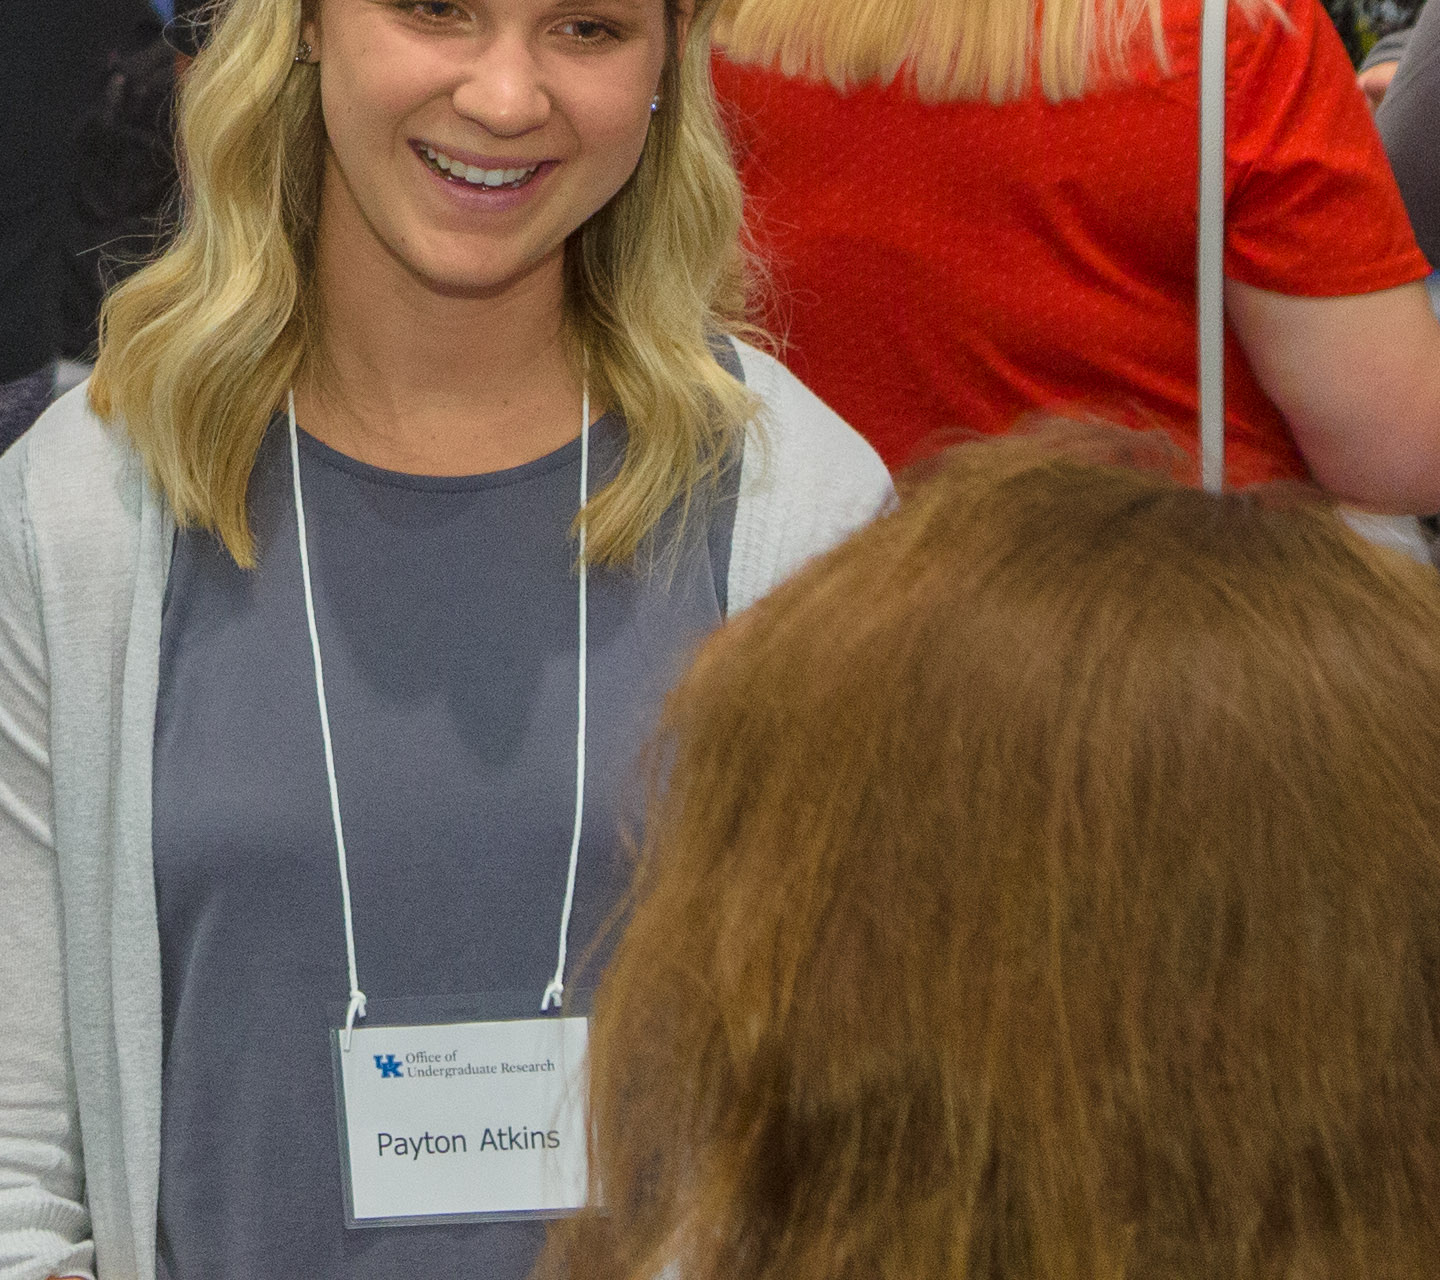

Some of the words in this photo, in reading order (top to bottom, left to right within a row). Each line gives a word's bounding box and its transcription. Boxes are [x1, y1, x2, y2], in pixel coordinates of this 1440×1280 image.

[405, 1051, 441, 1064] Office
[444, 1050, 458, 1063] of
[406, 1062, 498, 1079] Undergraduate
[500, 1059, 556, 1074] Research
[376, 1131, 468, 1161] Payton
[480, 1126, 561, 1152] Atkins
